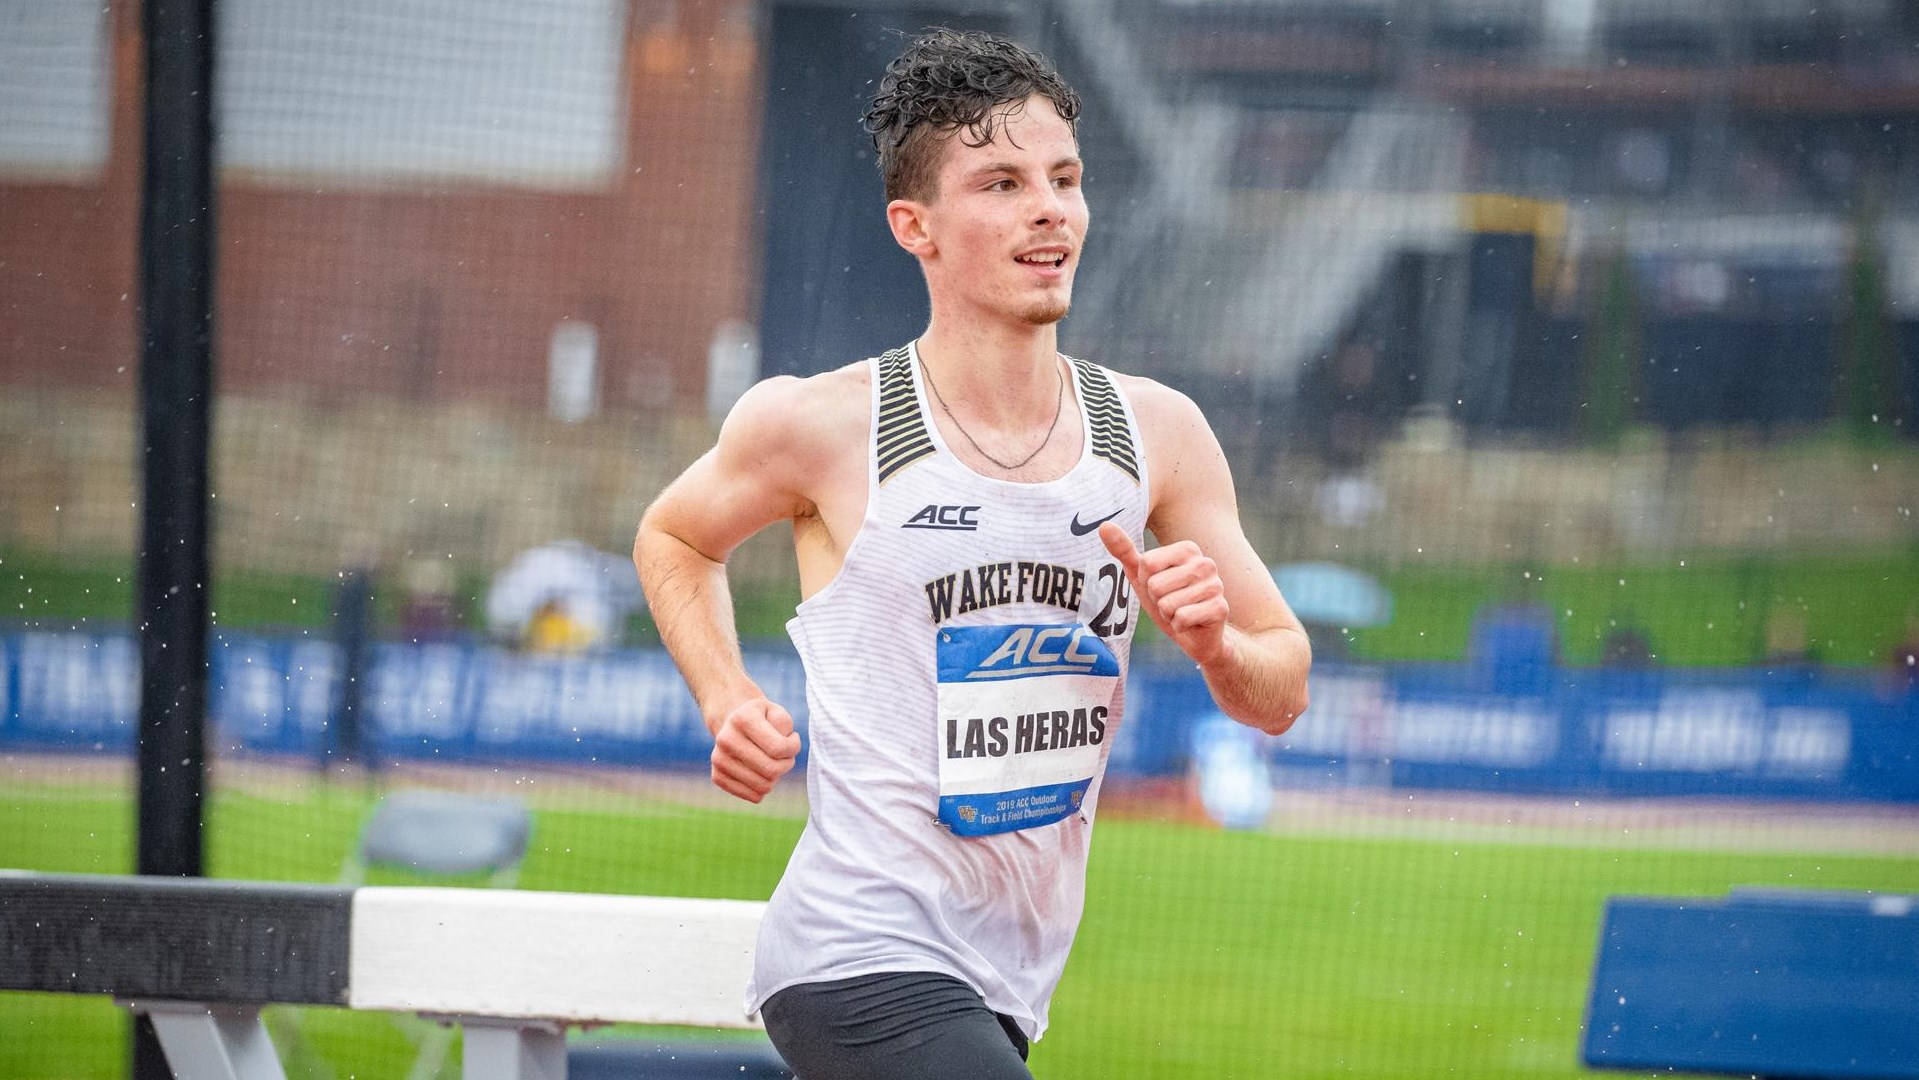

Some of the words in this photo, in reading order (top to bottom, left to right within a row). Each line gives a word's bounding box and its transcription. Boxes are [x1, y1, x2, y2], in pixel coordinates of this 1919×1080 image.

[906, 504, 982, 526] ACC
[925, 562, 1012, 625] WAKE
[1088, 563, 1131, 638] 29
[978, 627, 1098, 668] ACC
[946, 716, 1009, 759] LAS
[1014, 705, 1108, 755] HERAS
[981, 813, 1000, 824] Track
[996, 800, 1015, 811] 2019
[1016, 798, 1029, 808] ACC
[1030, 794, 1057, 806] Outdoor
